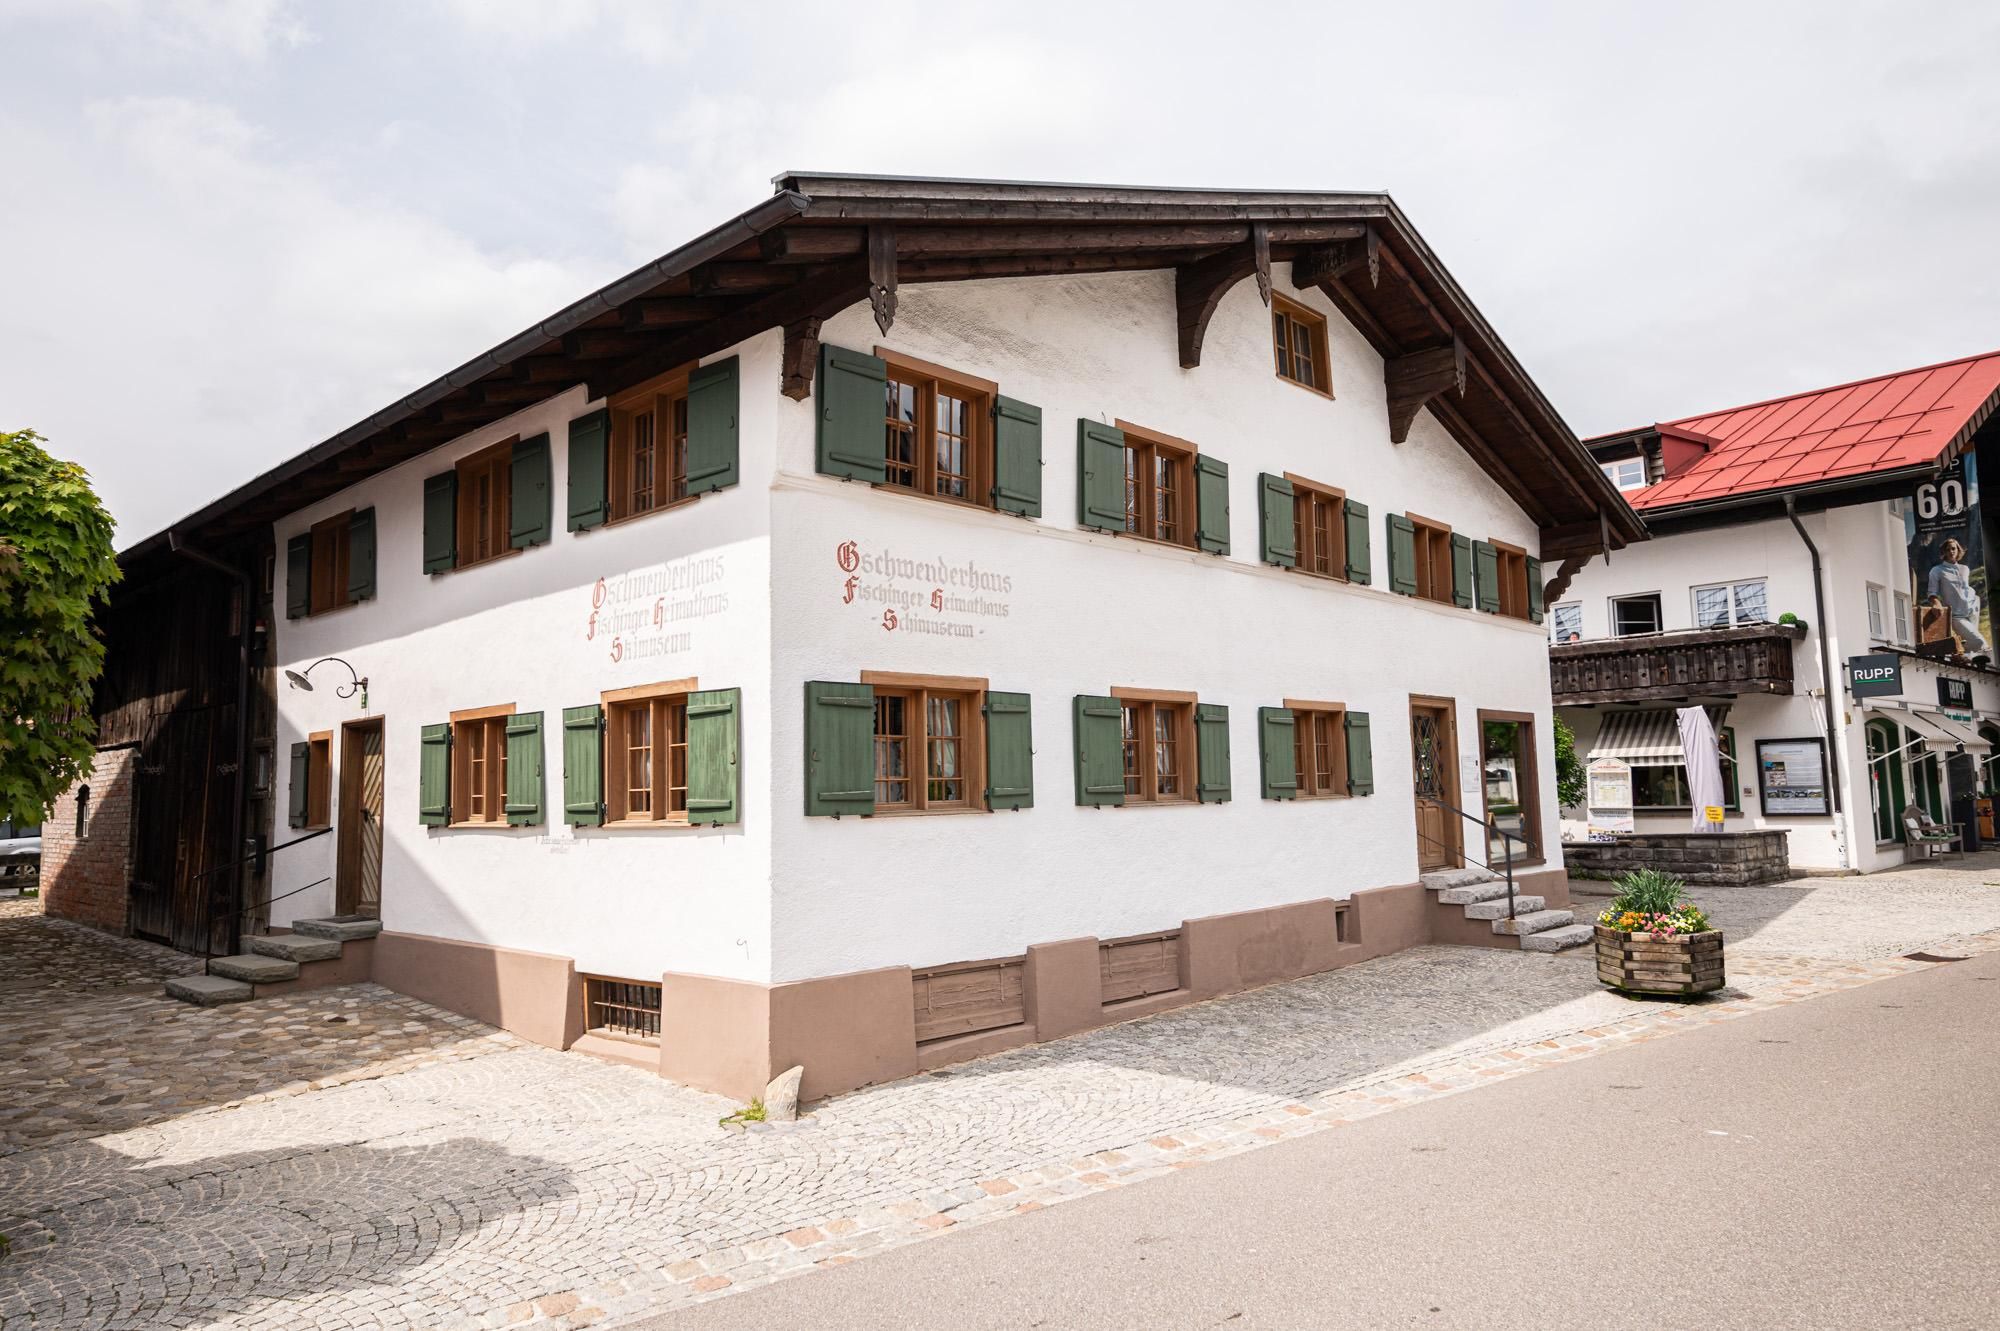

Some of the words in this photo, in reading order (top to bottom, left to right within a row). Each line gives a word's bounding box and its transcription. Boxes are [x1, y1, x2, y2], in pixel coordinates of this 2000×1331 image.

[1917, 479, 1963, 519] 60
[837, 540, 1012, 594] Gschwenderhaus
[843, 575, 925, 611] Fischinger
[930, 588, 1009, 618] Heimathaus
[1854, 667, 1894, 681] RUPP
